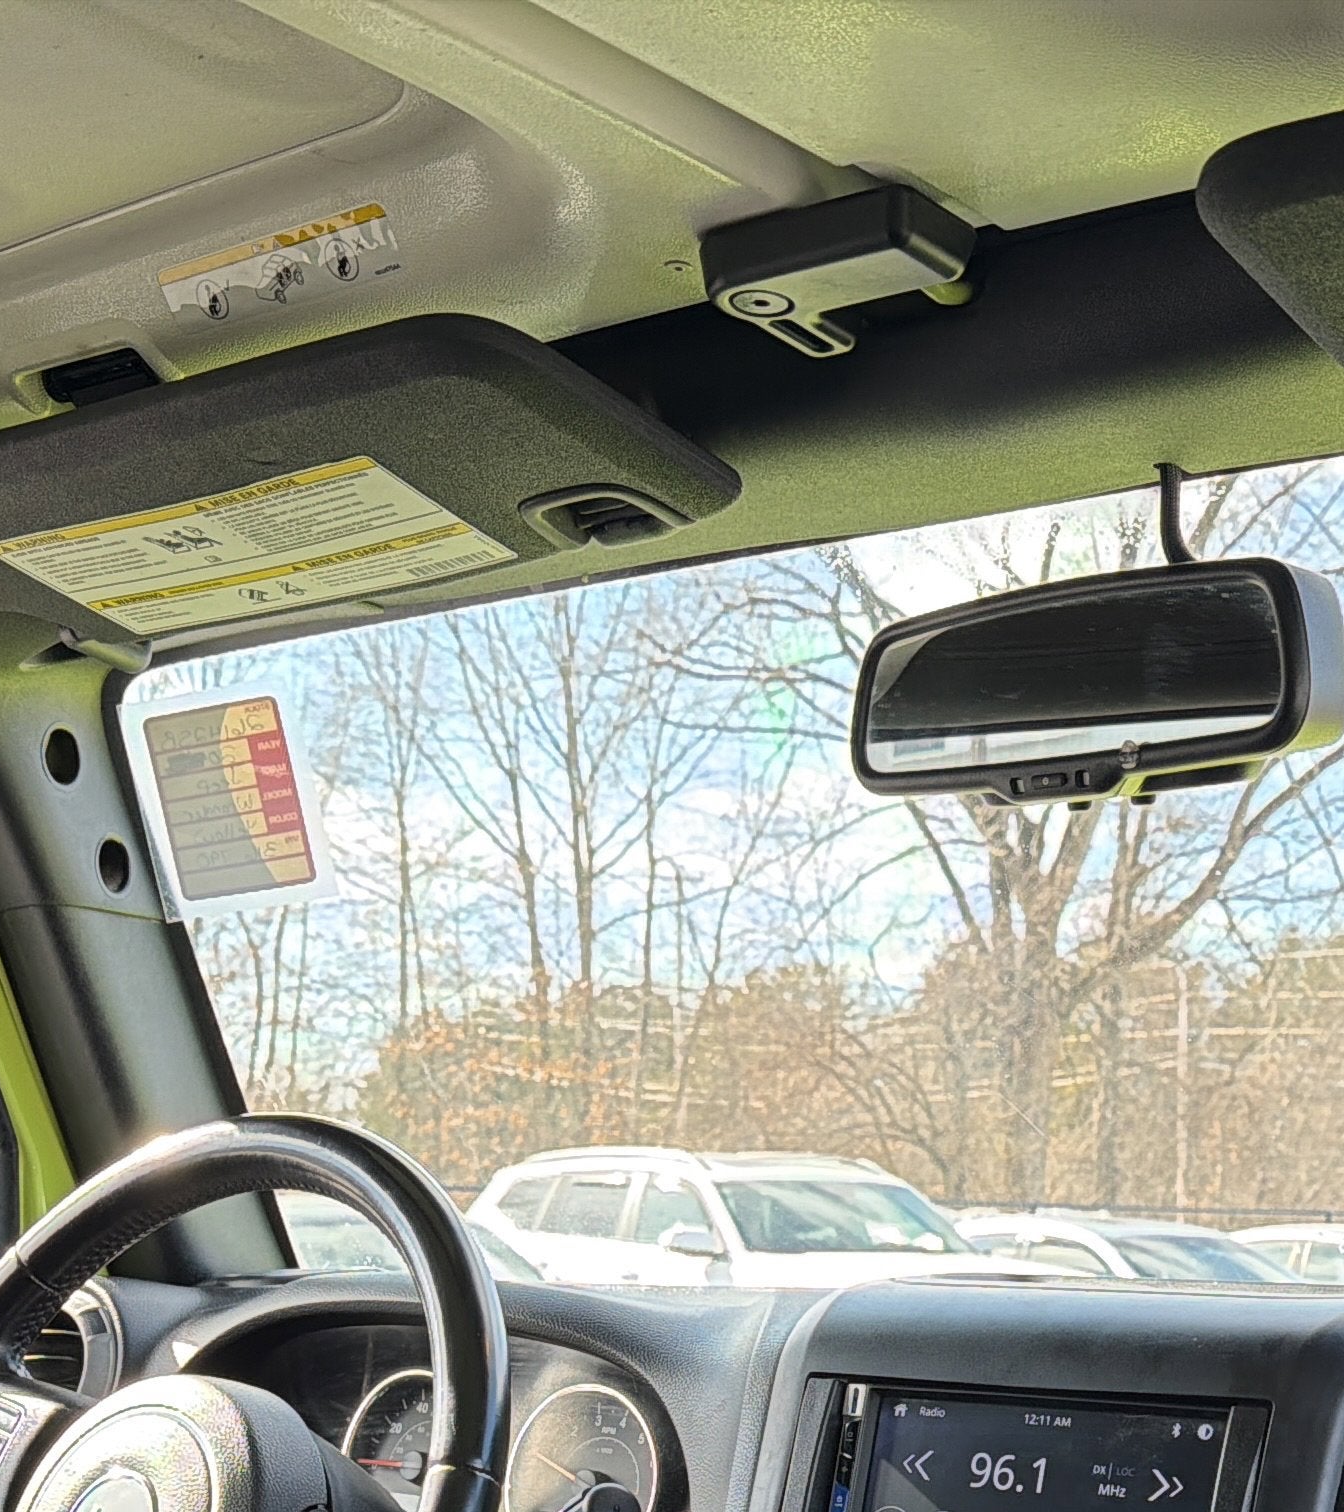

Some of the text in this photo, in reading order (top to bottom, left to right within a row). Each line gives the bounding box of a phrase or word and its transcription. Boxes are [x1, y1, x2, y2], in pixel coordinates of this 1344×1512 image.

[239, 489, 257, 500] EN
[257, 478, 299, 494] GARDE
[13, 533, 65, 550] WARNING
[353, 543, 394, 558] GARDE
[415, 1401, 429, 1414] 40
[919, 1406, 946, 1418] Radio
[594, 1414, 603, 1427] 3
[619, 1416, 627, 1429] 4
[1024, 1413, 1072, 1428] 12:11 AM
[389, 1422, 403, 1434] 20
[637, 1432, 646, 1445] 5
[969, 1451, 1047, 1494] 96.1
[1092, 1464, 1136, 1477] DX LOC
[1097, 1483, 1127, 1498] MHz
